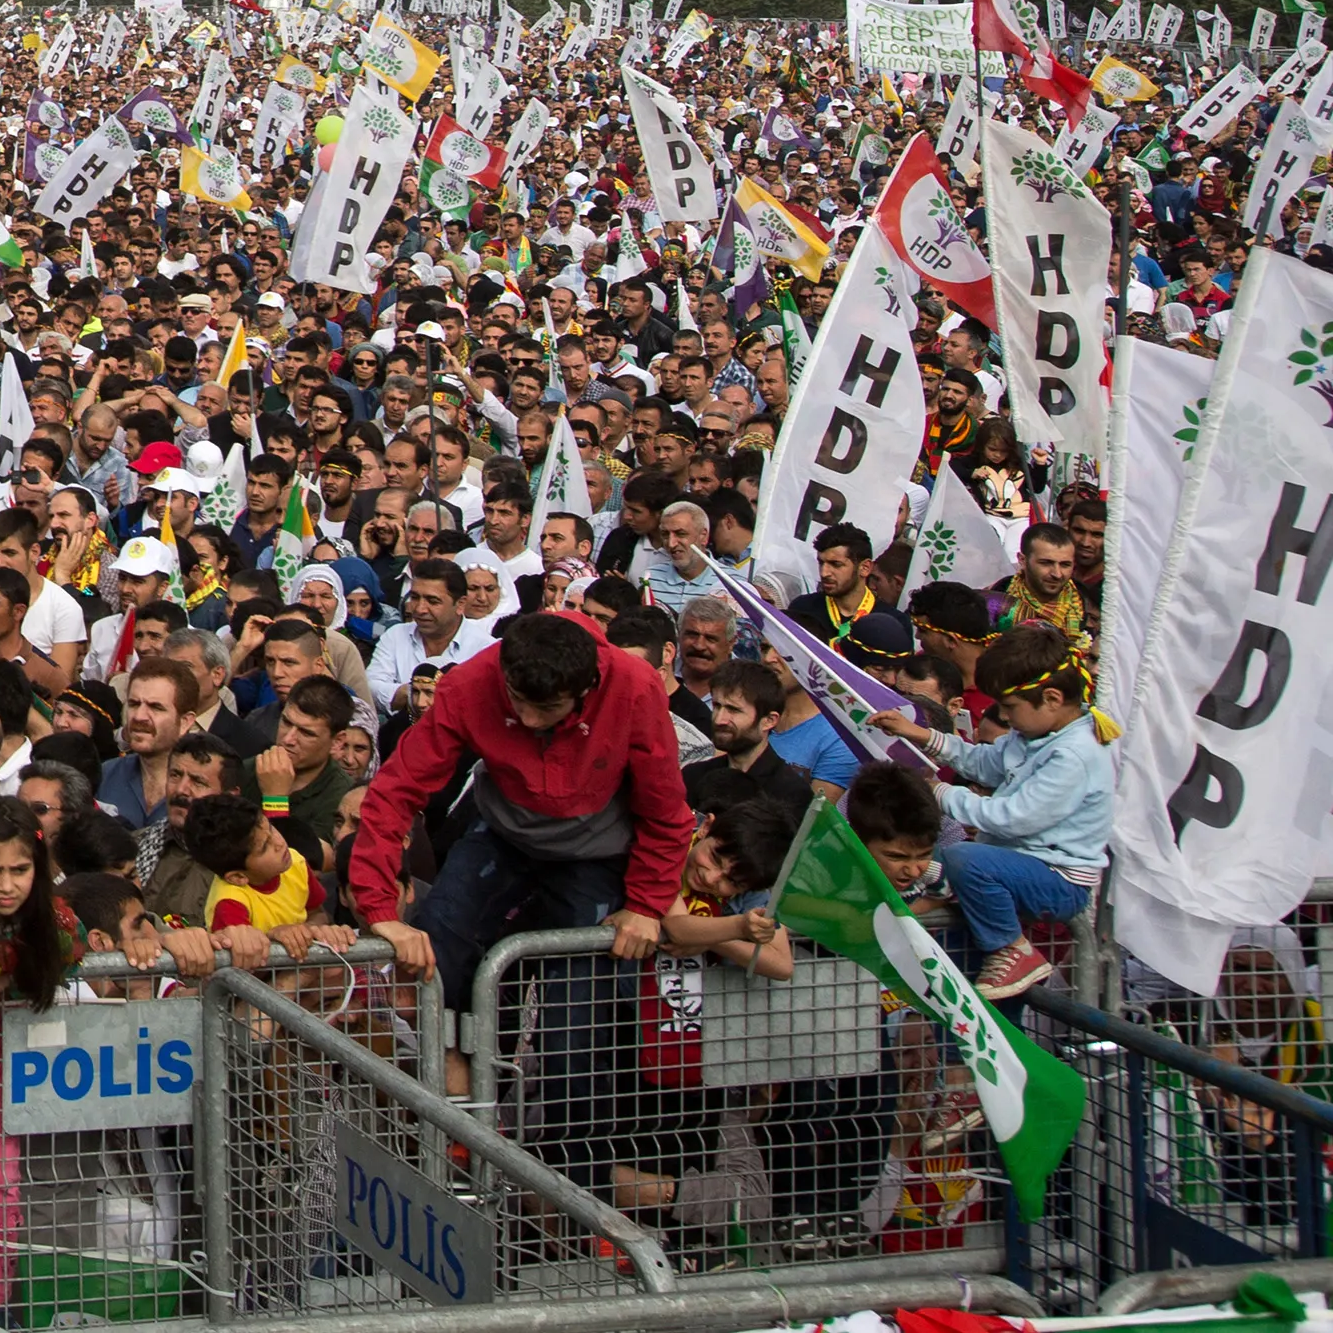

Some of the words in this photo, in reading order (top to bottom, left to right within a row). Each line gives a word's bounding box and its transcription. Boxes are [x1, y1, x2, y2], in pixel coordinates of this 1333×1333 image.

[157, 21, 167, 51] HDP
[286, 26, 294, 42] HD
[599, 7, 609, 37] HDP
[635, 21, 643, 40] HD
[864, 23, 933, 43] RECEP
[1053, 11, 1061, 36] HDP
[1090, 23, 1100, 39] HD
[1109, 19, 1124, 39] HD
[1161, 18, 1175, 44] HDP
[1257, 25, 1268, 45] HD
[47, 40, 68, 75] HDP
[502, 25, 514, 63] HDP
[565, 43, 581, 62] HD
[940, 58, 1007, 75] GELYOR
[203, 85, 222, 133] HDP
[1189, 85, 1240, 129] HDP
[264, 117, 281, 154] HD
[949, 115, 973, 157] HD
[449, 159, 469, 172] HDP
[654, 106, 696, 208] HDP
[52, 153, 108, 216] HDP
[209, 186, 226, 199] HDP
[330, 155, 382, 276] HDP
[757, 236, 783, 253] HDP
[909, 237, 952, 271] HDP
[1026, 233, 1081, 416] HDP
[433, 392, 461, 406] ISTAN
[793, 333, 902, 543] HDP
[1168, 481, 1333, 852] HDP
[11, 1027, 194, 1104] POLİS
[343, 1154, 466, 1302] POLİS
